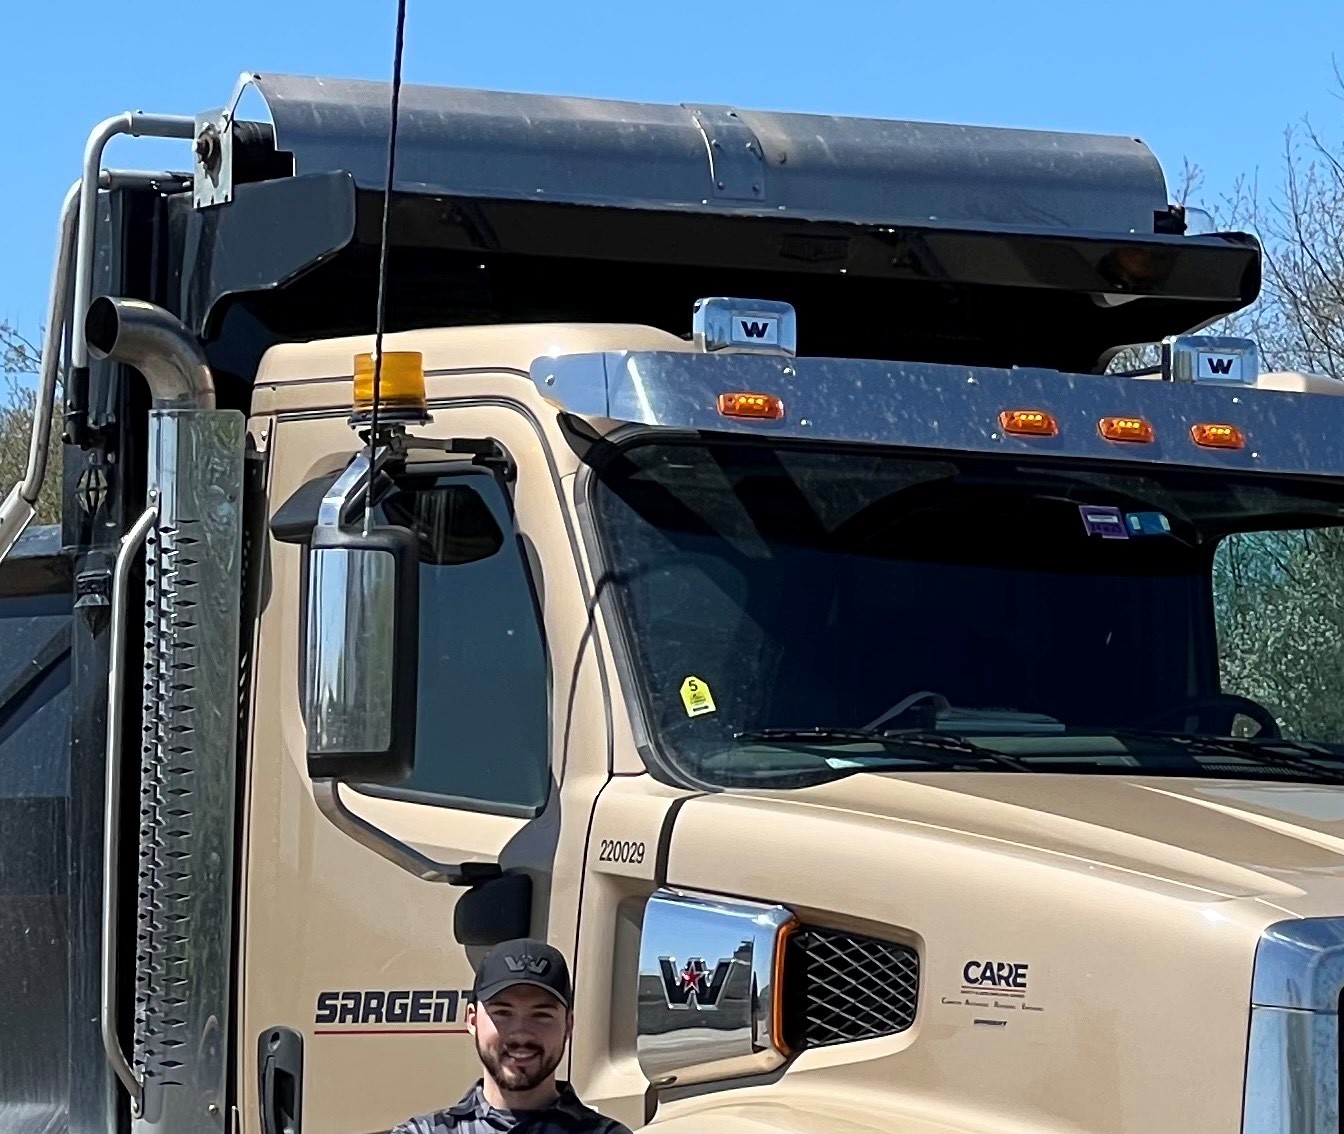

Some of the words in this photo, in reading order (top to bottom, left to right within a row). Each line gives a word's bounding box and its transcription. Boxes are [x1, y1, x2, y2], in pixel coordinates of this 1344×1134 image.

[740, 320, 769, 339] W
[1207, 357, 1233, 375] W
[688, 679, 698, 692] 5
[599, 839, 645, 864] 220029
[963, 960, 1029, 988] CARE
